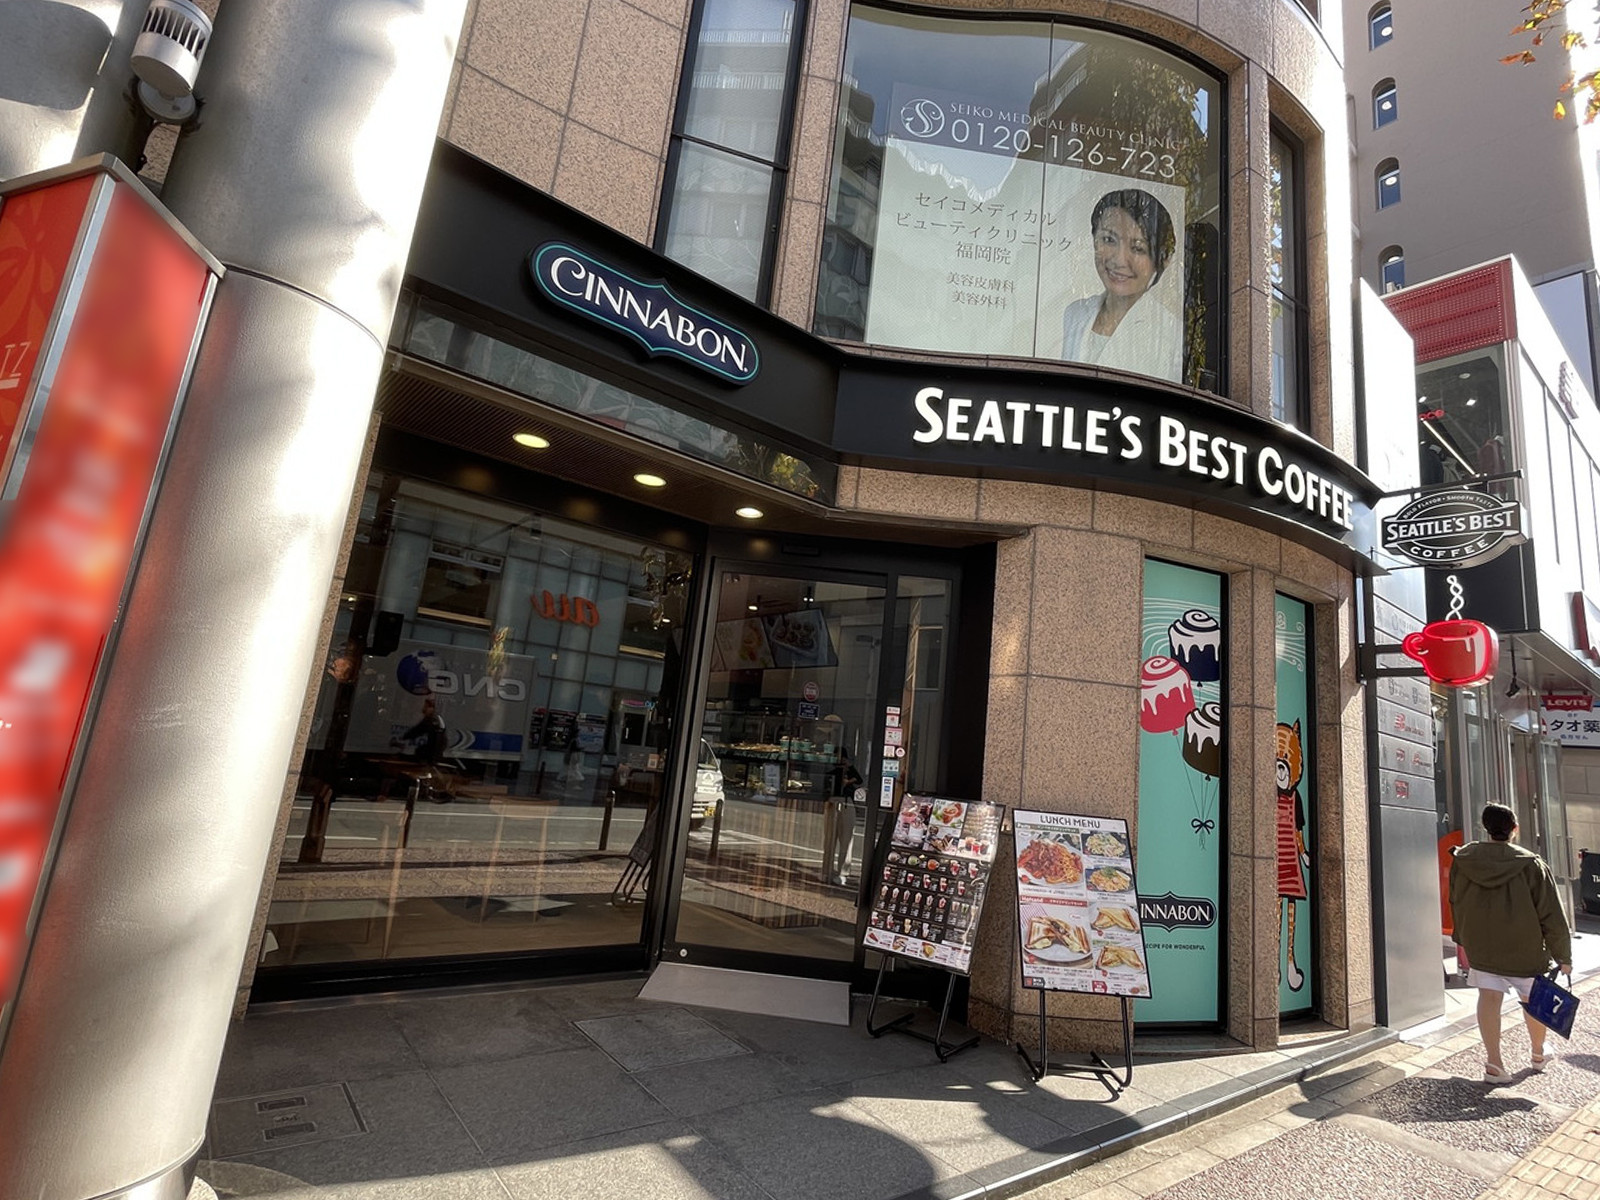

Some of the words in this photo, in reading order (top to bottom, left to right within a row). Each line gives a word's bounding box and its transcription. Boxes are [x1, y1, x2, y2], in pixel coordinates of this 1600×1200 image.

[950, 103, 994, 119] SEIKO
[998, 110, 1065, 131] MEDICAL
[1071, 122, 1125, 140] BEAUTY
[1130, 132, 1181, 151] CLINIC
[952, 119, 1176, 178] 0120-126-723
[915, 192, 1057, 226] セイコメディカル
[897, 212, 1072, 252] ビューティクリニック
[956, 240, 1011, 265] 福岡院
[946, 271, 1015, 294] 美容皮膚科
[952, 290, 1007, 309] 美容外科
[913, 387, 1142, 459] SEATTLE'S
[1159, 416, 1248, 485] BEST
[1258, 447, 1354, 531] COFFEE
[1418, 497, 1441, 509] FLAVOR
[1387, 518, 1466, 541] SEATTLE'S
[1470, 510, 1514, 530] BEST
[1410, 539, 1488, 558] COFFEE
[1550, 719, 1600, 733] タオ薬
[1040, 815, 1071, 826] LUNCH
[1073, 819, 1101, 829] MENU
[1140, 903, 1210, 921] INNABON
